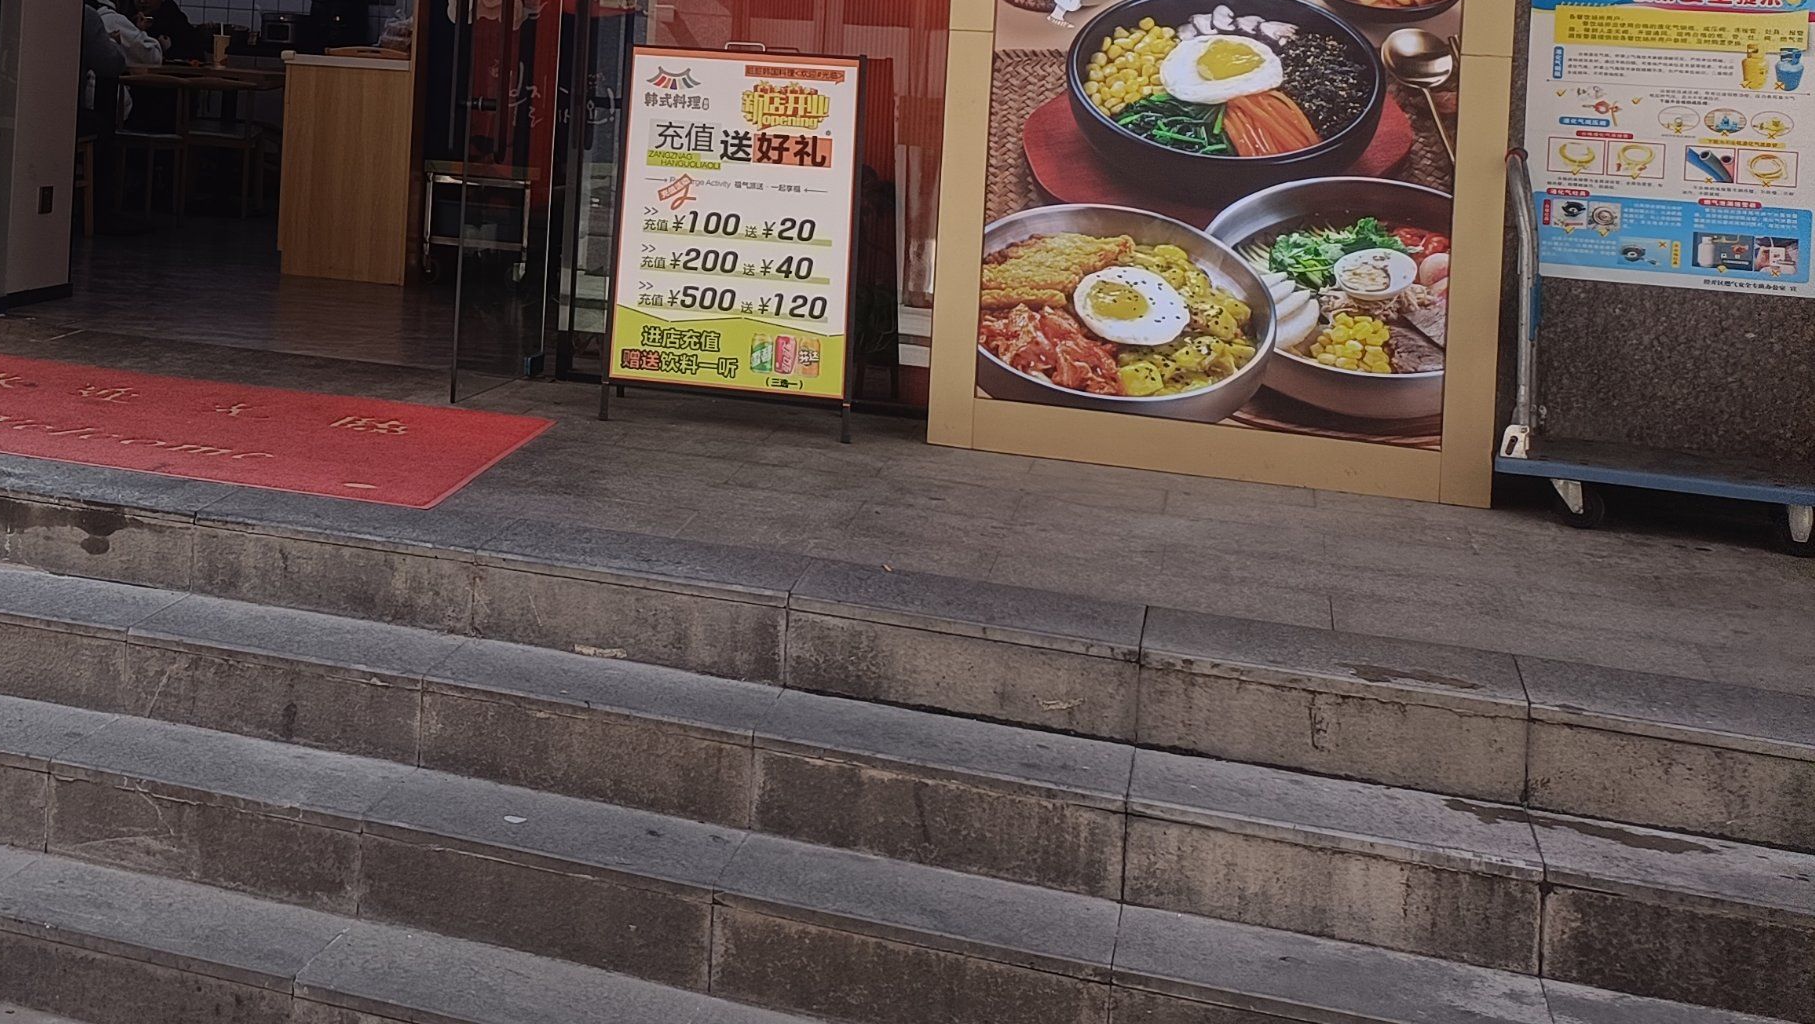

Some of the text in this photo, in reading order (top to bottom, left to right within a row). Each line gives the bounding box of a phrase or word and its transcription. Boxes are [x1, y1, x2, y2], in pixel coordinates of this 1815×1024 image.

[644, 91, 702, 109] 韩式料理
[742, 89, 830, 127] 新店开业
[706, 179, 732, 189] Activity
[643, 210, 816, 243] 充值 ¥100 送 ¥20
[641, 247, 814, 280] 充值 ¥200 送 ¥40
[638, 285, 828, 320] 充值 ¥500 送 ¥120
[641, 326, 720, 352] 进店充值
[621, 348, 739, 378] 赠送饮料一听
